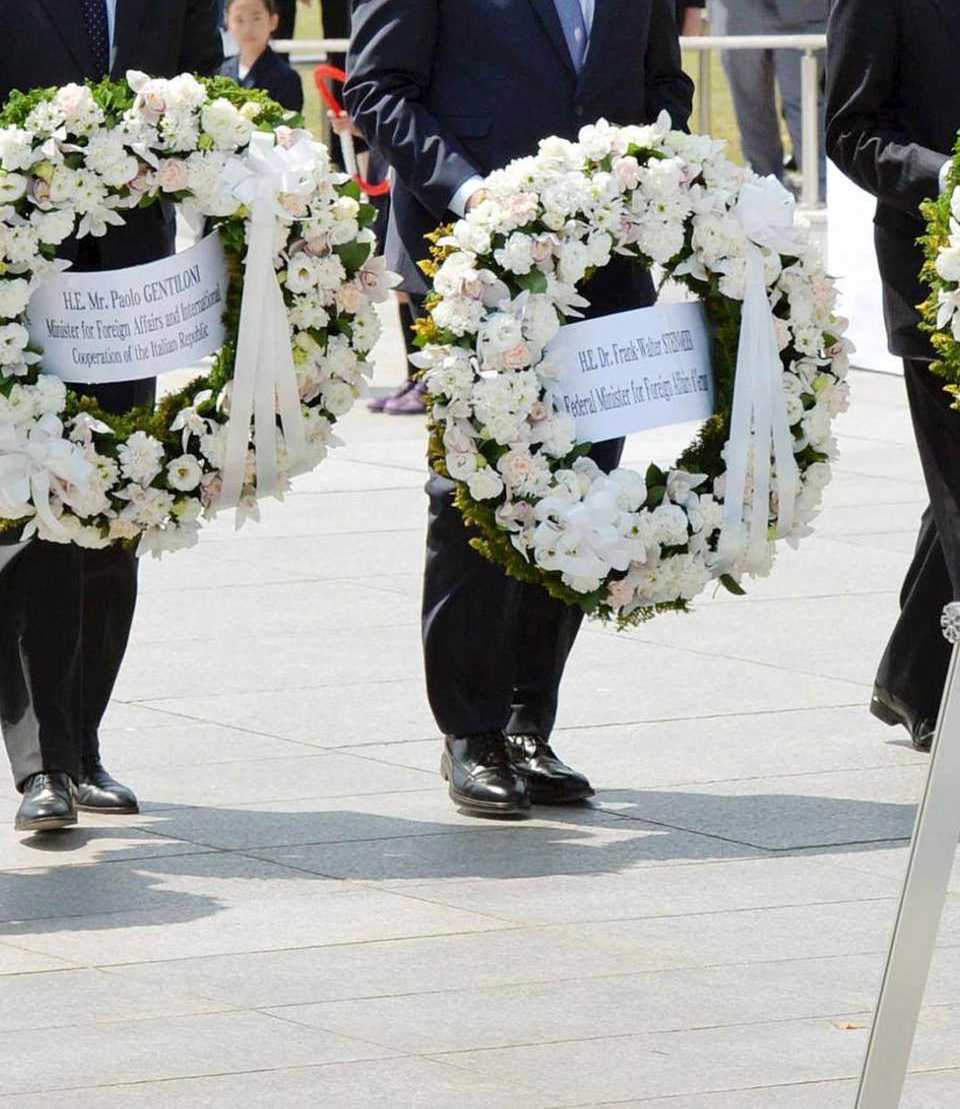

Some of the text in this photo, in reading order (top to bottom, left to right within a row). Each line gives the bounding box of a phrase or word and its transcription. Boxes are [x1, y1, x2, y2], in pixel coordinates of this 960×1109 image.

[63, 290, 86, 311] H.E.
[88, 292, 108, 310] Mr.
[110, 287, 141, 309] Paolo
[45, 318, 80, 339] Minister
[81, 320, 94, 339] for
[96, 320, 131, 341] Foreign
[133, 313, 164, 336] Affairs
[165, 309, 181, 327] and
[72, 347, 122, 368] Cooperation
[123, 345, 133, 363] of
[134, 343, 149, 361] the
[150, 334, 178, 358] Italian
[598, 346, 614, 369] Dr.
[564, 388, 598, 418] Federal
[595, 385, 631, 412] Minister
[630, 380, 644, 404] for
[643, 374, 673, 402] Foreign
